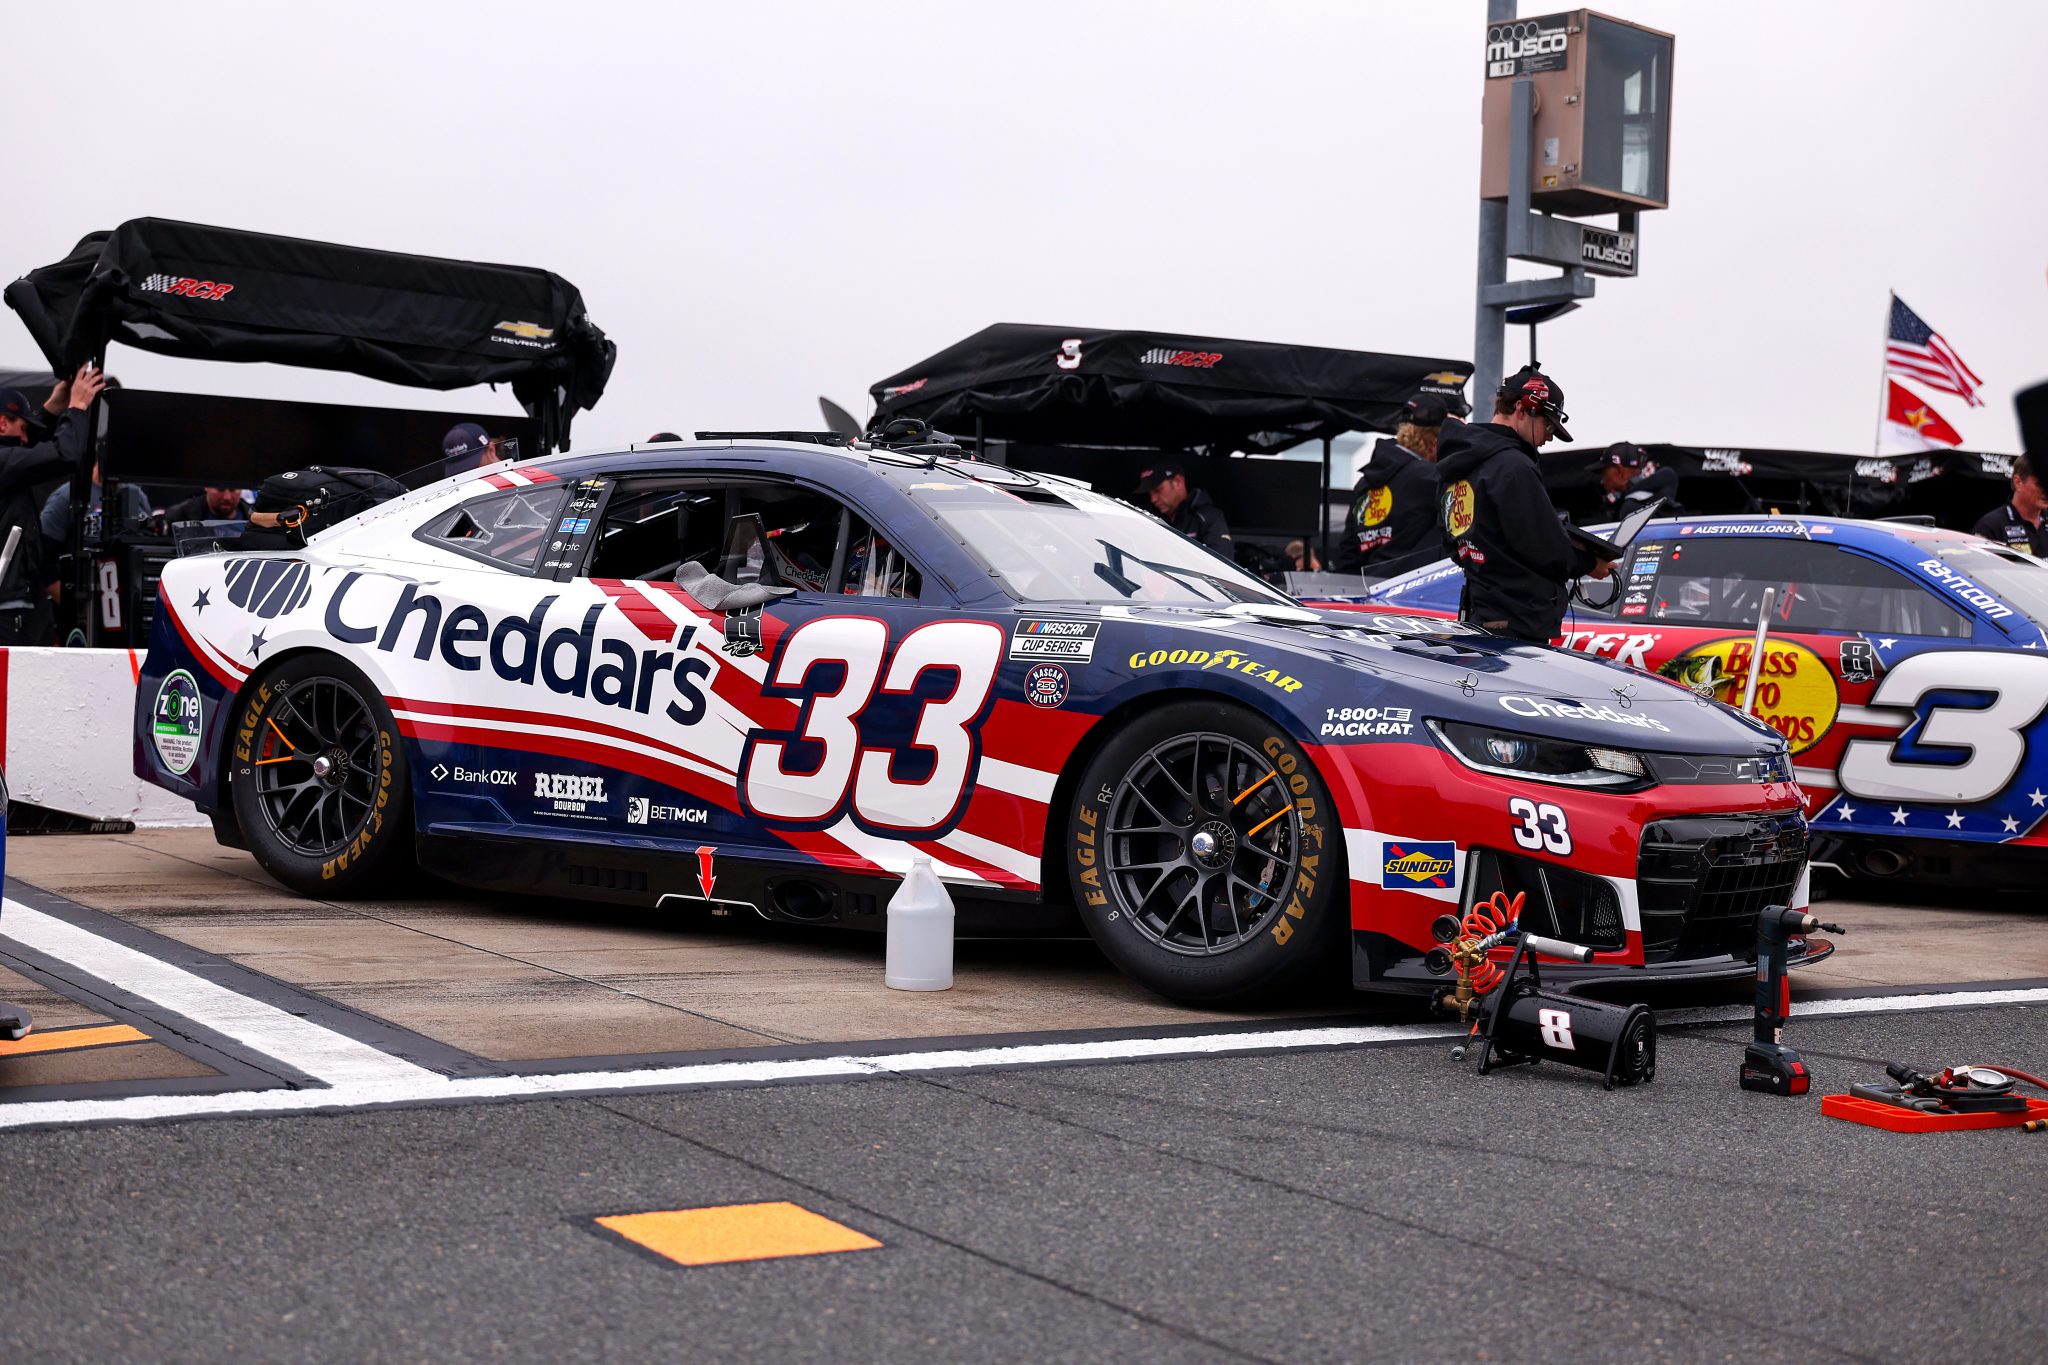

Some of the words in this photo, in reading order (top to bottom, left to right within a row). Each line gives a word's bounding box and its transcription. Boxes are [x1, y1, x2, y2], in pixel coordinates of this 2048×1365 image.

[1057, 339, 1083, 370] 3
[1693, 525, 1794, 534] AUSTINDILLON3
[100, 561, 122, 629] 8
[1022, 639, 1044, 651] CUP
[1044, 640, 1083, 653] SERIES
[1040, 622, 1088, 635] NASCAR
[324, 572, 712, 727] Cheddar's
[1033, 668, 1063, 681] NASCAR
[1129, 649, 1303, 694] GOODYEAR
[1030, 690, 1062, 704] SALUTES
[1498, 696, 1671, 733] Cheddar's
[237, 682, 272, 762] EAGLE
[745, 616, 1004, 829] 33
[1838, 651, 2048, 803] 3
[534, 772, 608, 803] REBEL
[553, 800, 586, 812] BOURBON
[651, 806, 707, 823] BETMGM
[1510, 797, 1571, 855] 33
[1077, 805, 1108, 906] EAGLE
[1263, 736, 1325, 946] GOODYEAR
[1387, 860, 1451, 873] SUNOCO
[1539, 1008, 1576, 1051] 8
